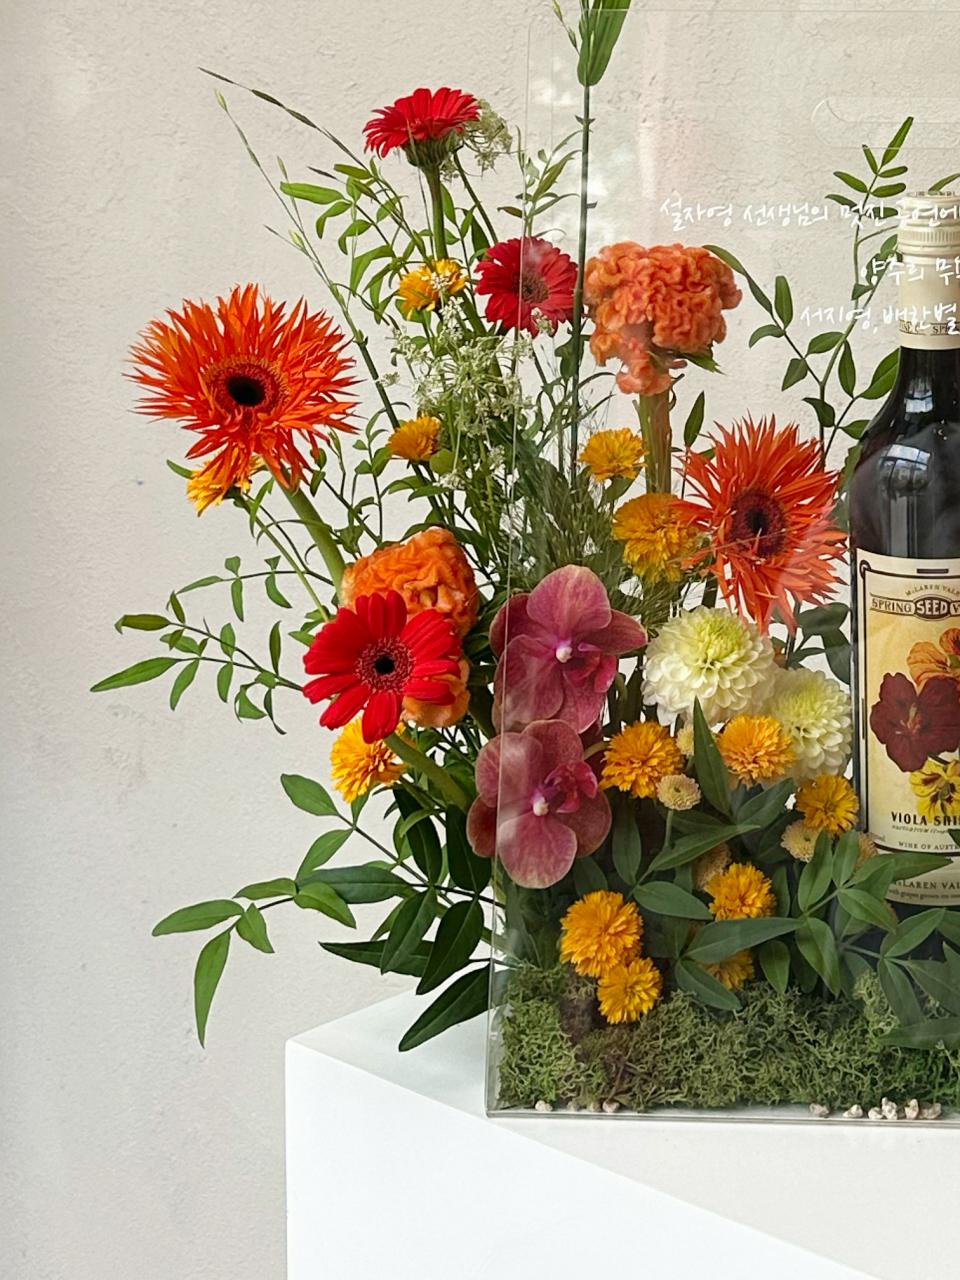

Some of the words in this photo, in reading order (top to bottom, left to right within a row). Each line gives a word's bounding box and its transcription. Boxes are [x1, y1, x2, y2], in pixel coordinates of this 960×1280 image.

[743, 202, 828, 227] 선생님의
[839, 201, 886, 229] 멋진
[872, 598, 912, 613] SPRING
[916, 599, 947, 616] SEED
[891, 811, 928, 827] VIOLA
